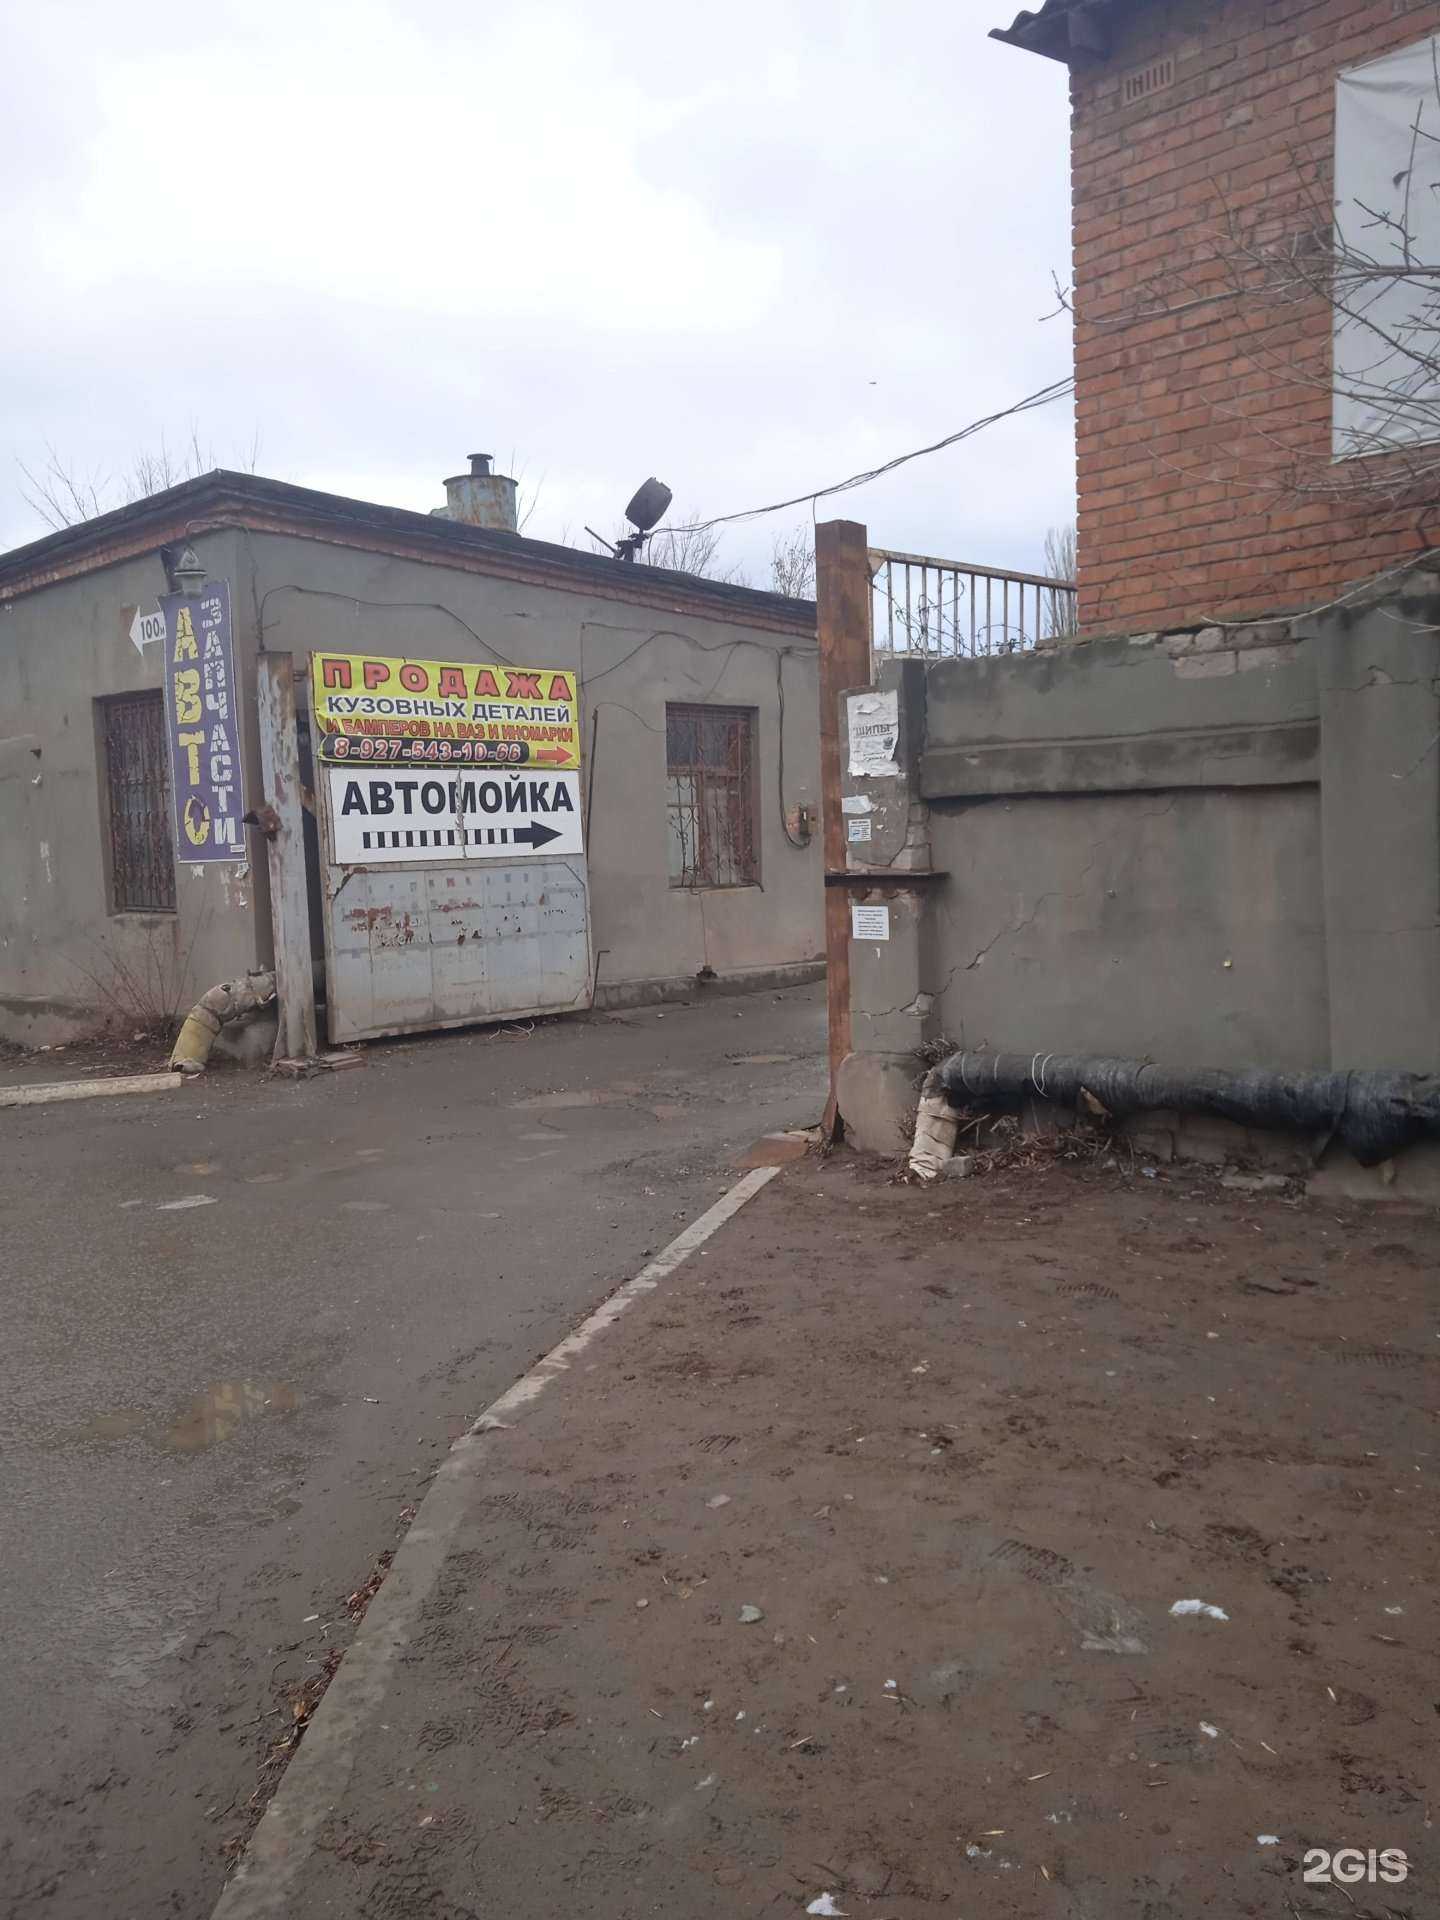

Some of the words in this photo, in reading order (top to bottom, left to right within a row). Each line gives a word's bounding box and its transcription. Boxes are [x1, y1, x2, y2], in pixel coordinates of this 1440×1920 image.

[322, 658, 573, 702] ПРОДАЖА
[172, 606, 211, 846] АВТО
[201, 598, 236, 845] ЗАПЧАСТИ
[327, 696, 467, 718] КУЗОВНЫХ
[472, 703, 570, 723] ДЕТАЛЕЙ
[327, 718, 339, 733] И
[342, 718, 431, 737] БАМПЕРОВ
[433, 721, 455, 738] НА
[457, 722, 486, 739] ВАЗ
[488, 724, 499, 739] И
[501, 724, 573, 743] ИНОМАРКИ
[334, 737, 521, 761] 8-927-543-10-66
[341, 774, 575, 816] АВТОМОЙКА
